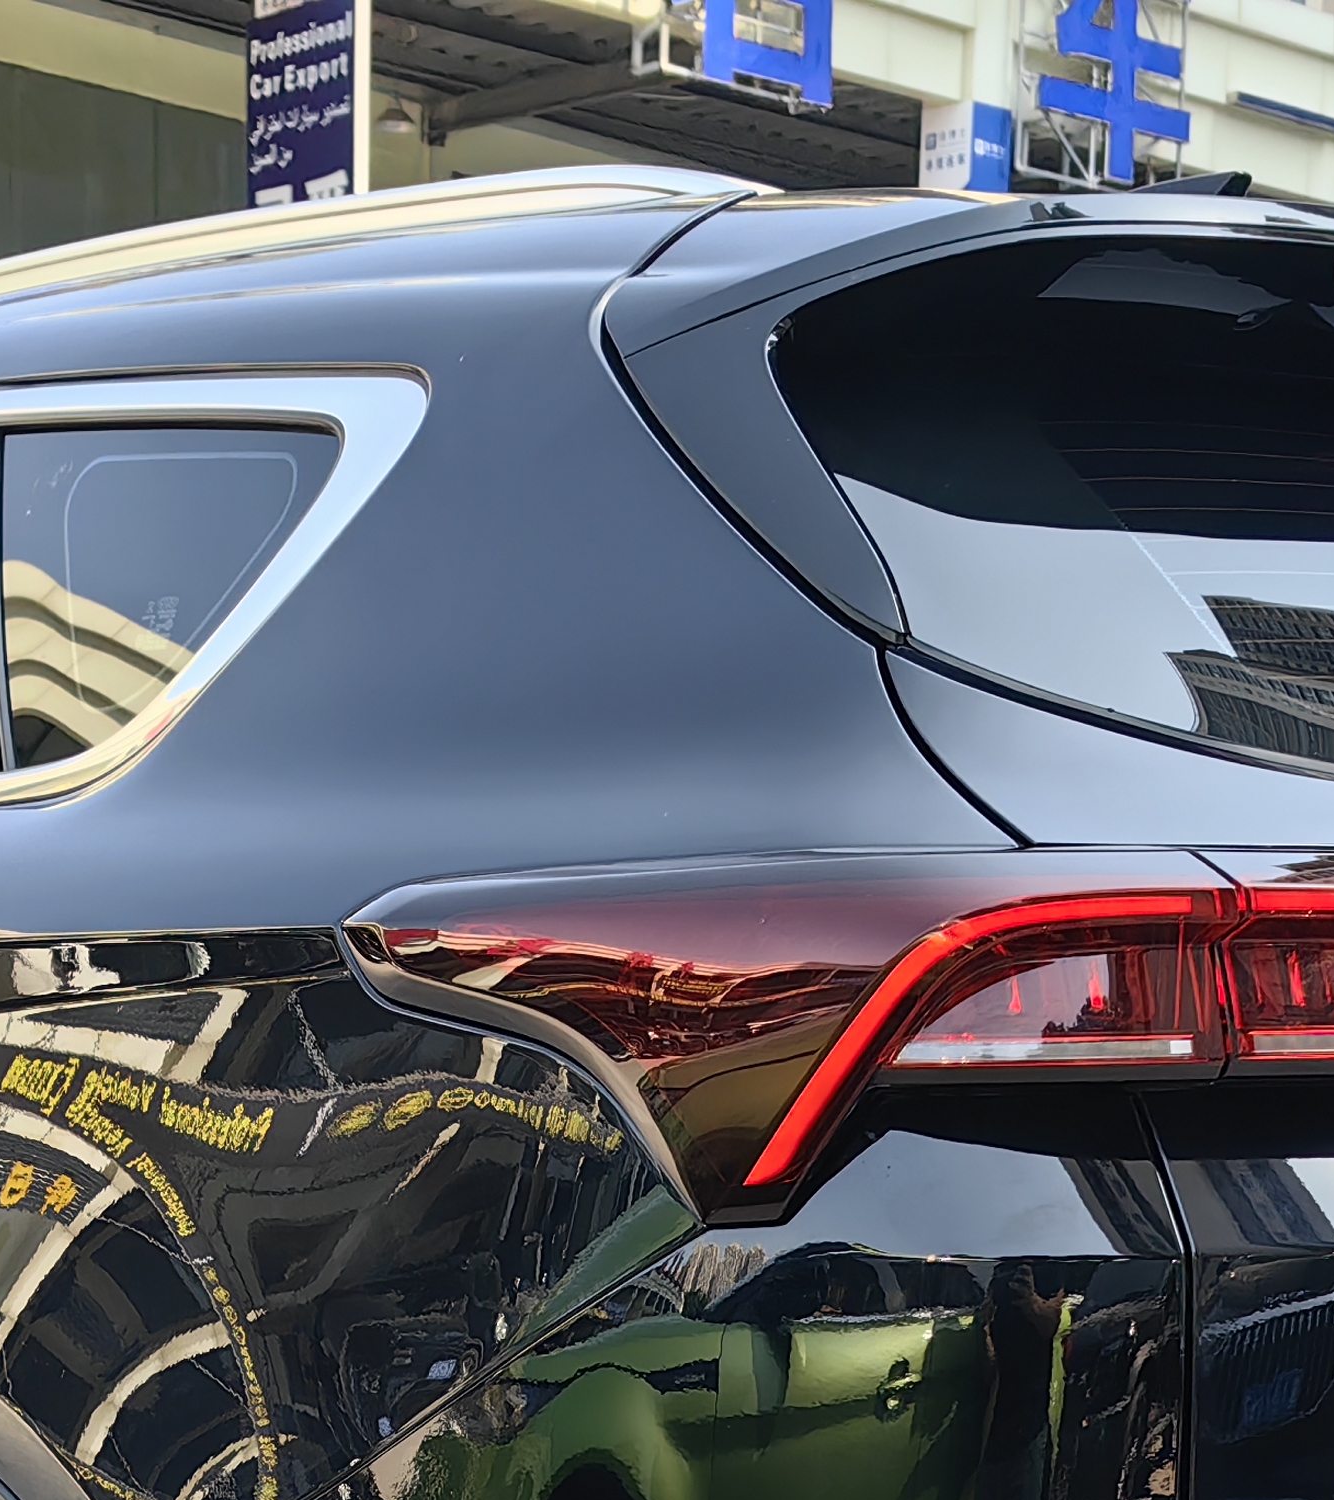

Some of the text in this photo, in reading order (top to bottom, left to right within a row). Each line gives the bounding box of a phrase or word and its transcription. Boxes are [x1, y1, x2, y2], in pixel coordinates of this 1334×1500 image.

[250, 10, 352, 67] Professional
[250, 52, 348, 100] Car Export
